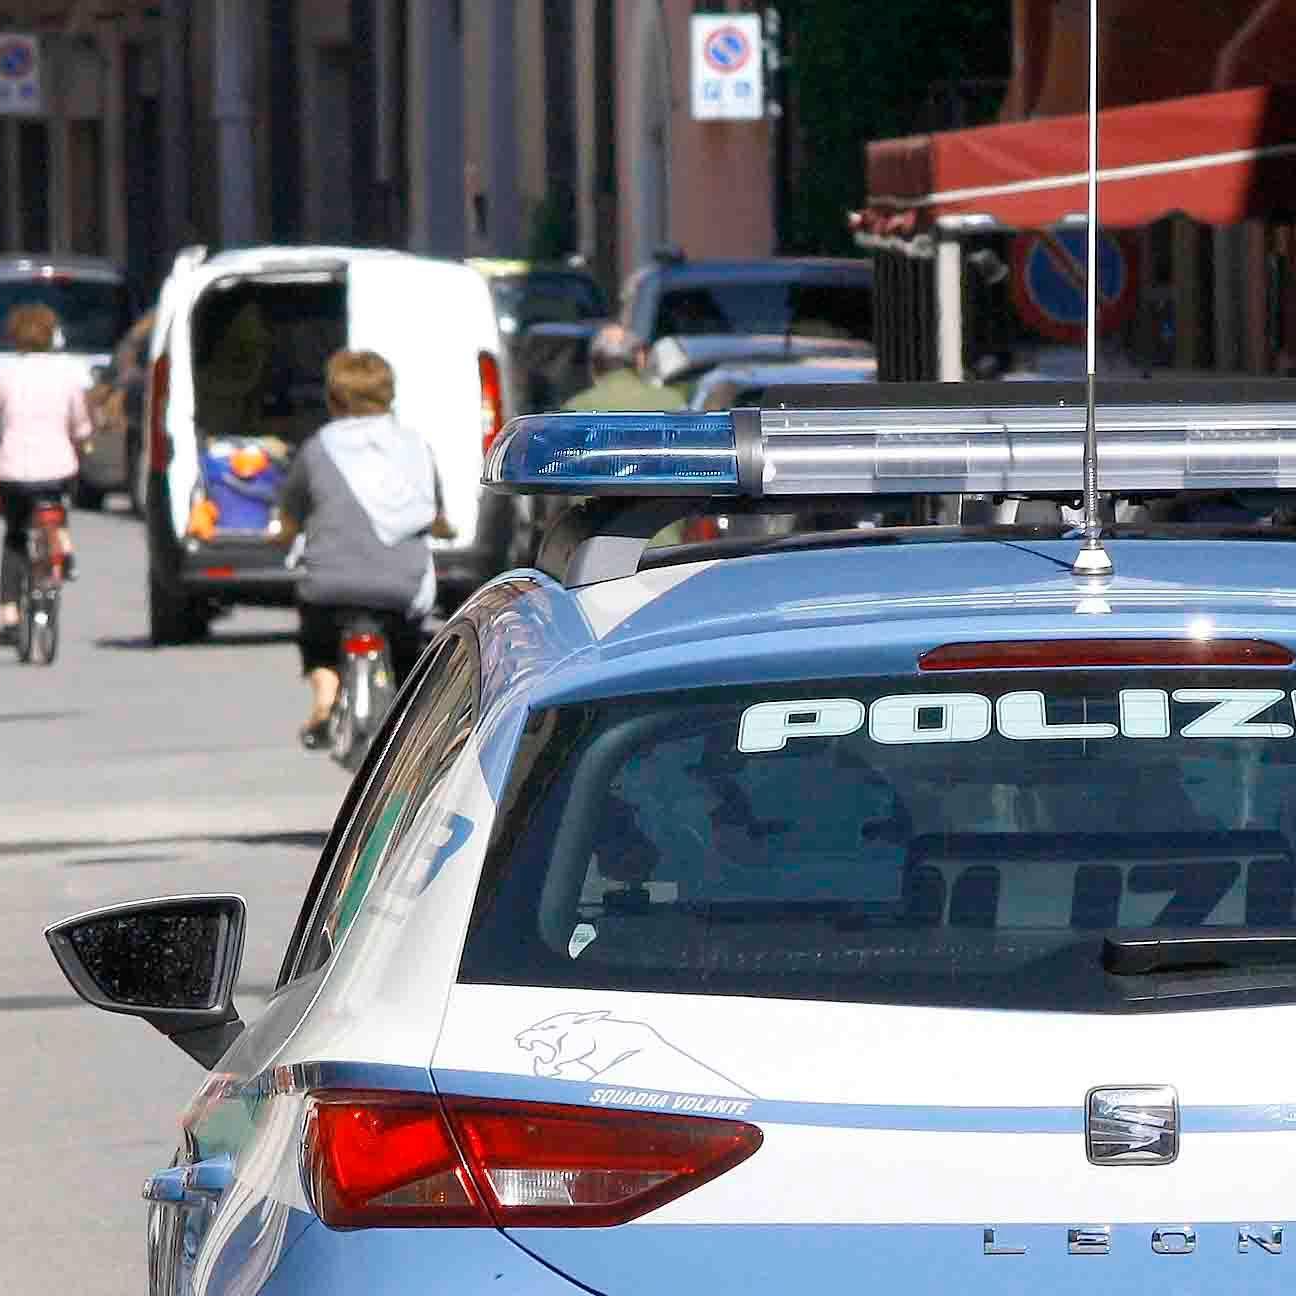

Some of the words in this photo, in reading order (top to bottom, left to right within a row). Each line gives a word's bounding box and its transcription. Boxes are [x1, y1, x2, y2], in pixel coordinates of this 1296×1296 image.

[589, 1088, 669, 1109] SQUADRA
[672, 1095, 749, 1116] VOLANTE
[984, 1225, 1283, 1255] LEON
